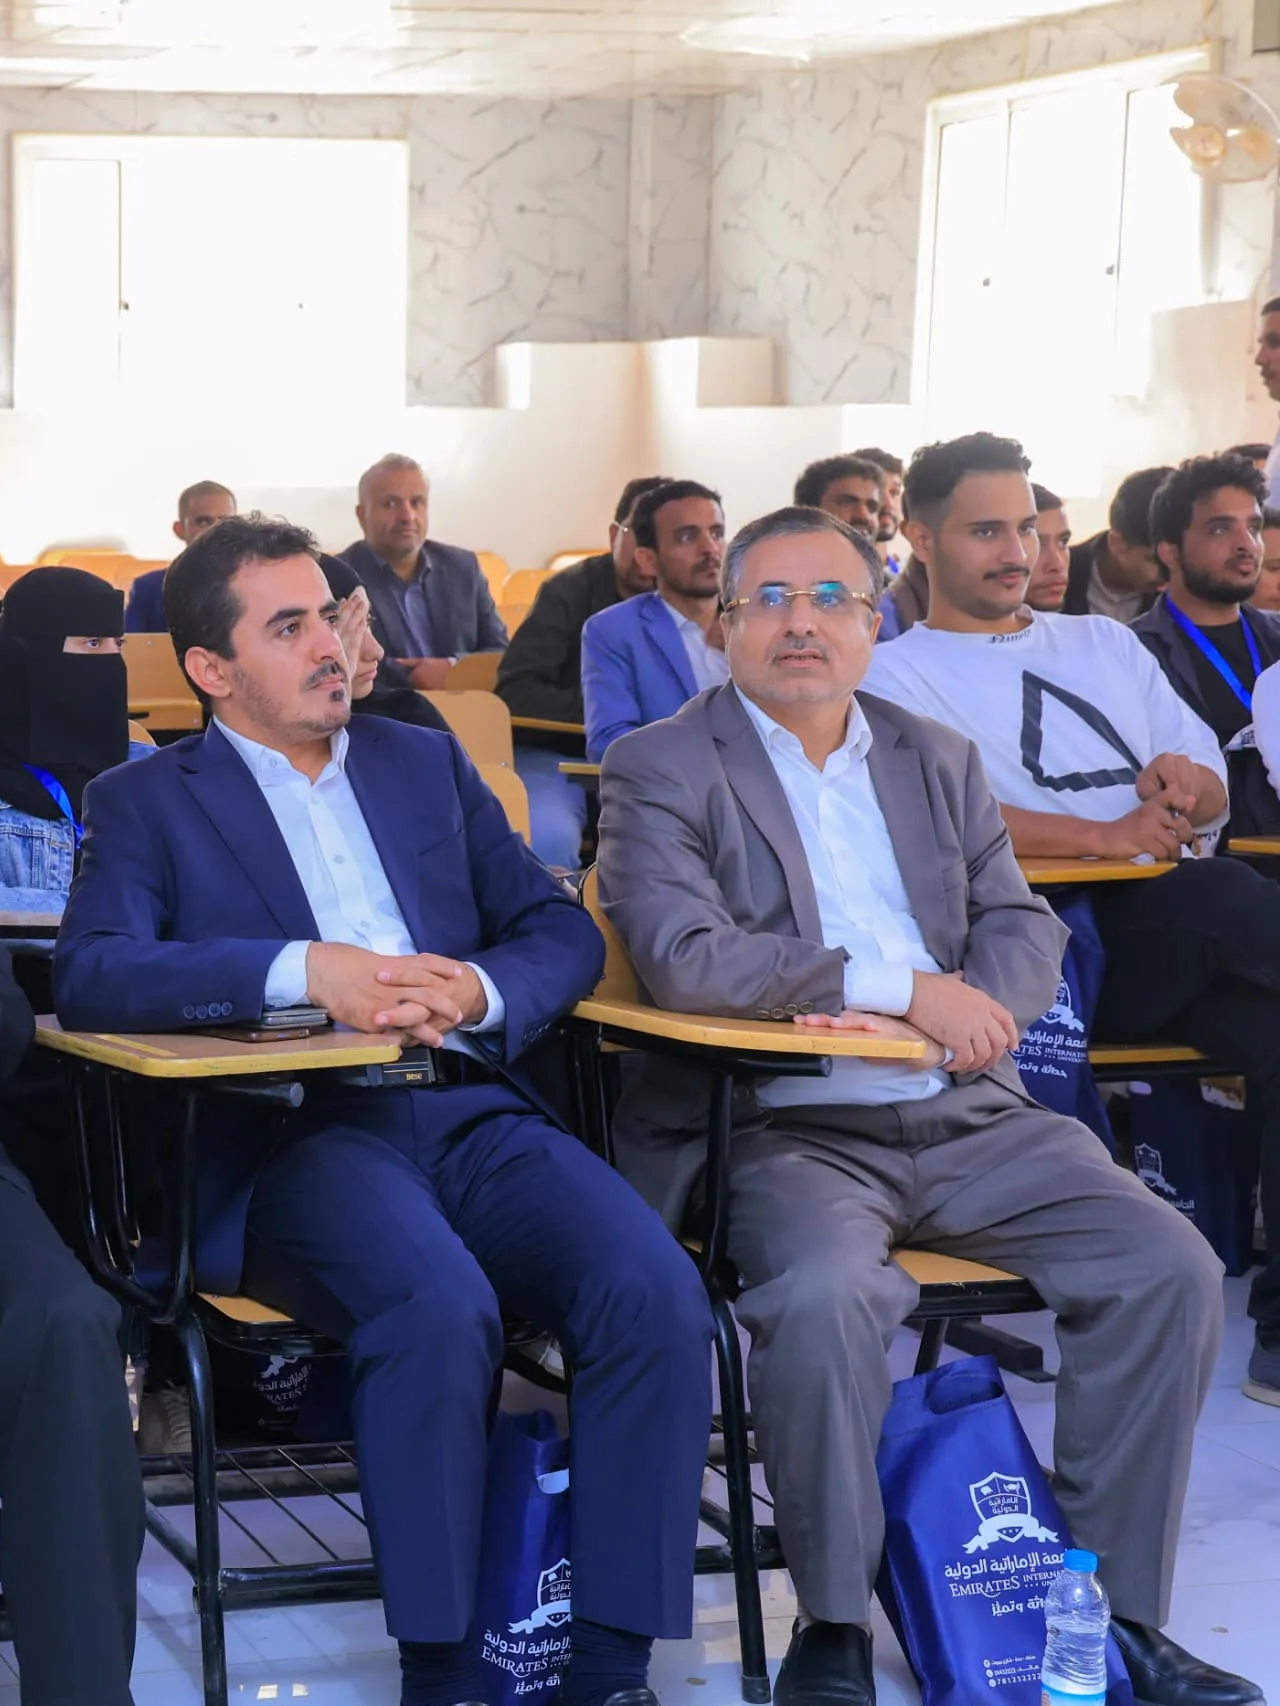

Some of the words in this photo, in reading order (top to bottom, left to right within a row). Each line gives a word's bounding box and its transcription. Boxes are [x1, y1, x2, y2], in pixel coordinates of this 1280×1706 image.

[944, 1558, 988, 1580] الدولية
[990, 1552, 1041, 1574] الإماراتية
[949, 1575, 1021, 1598] EMIRATES
[484, 1629, 525, 1655] الدولية
[527, 1636, 571, 1656] لإماراتية
[481, 1645, 548, 1678] EMIRATES
